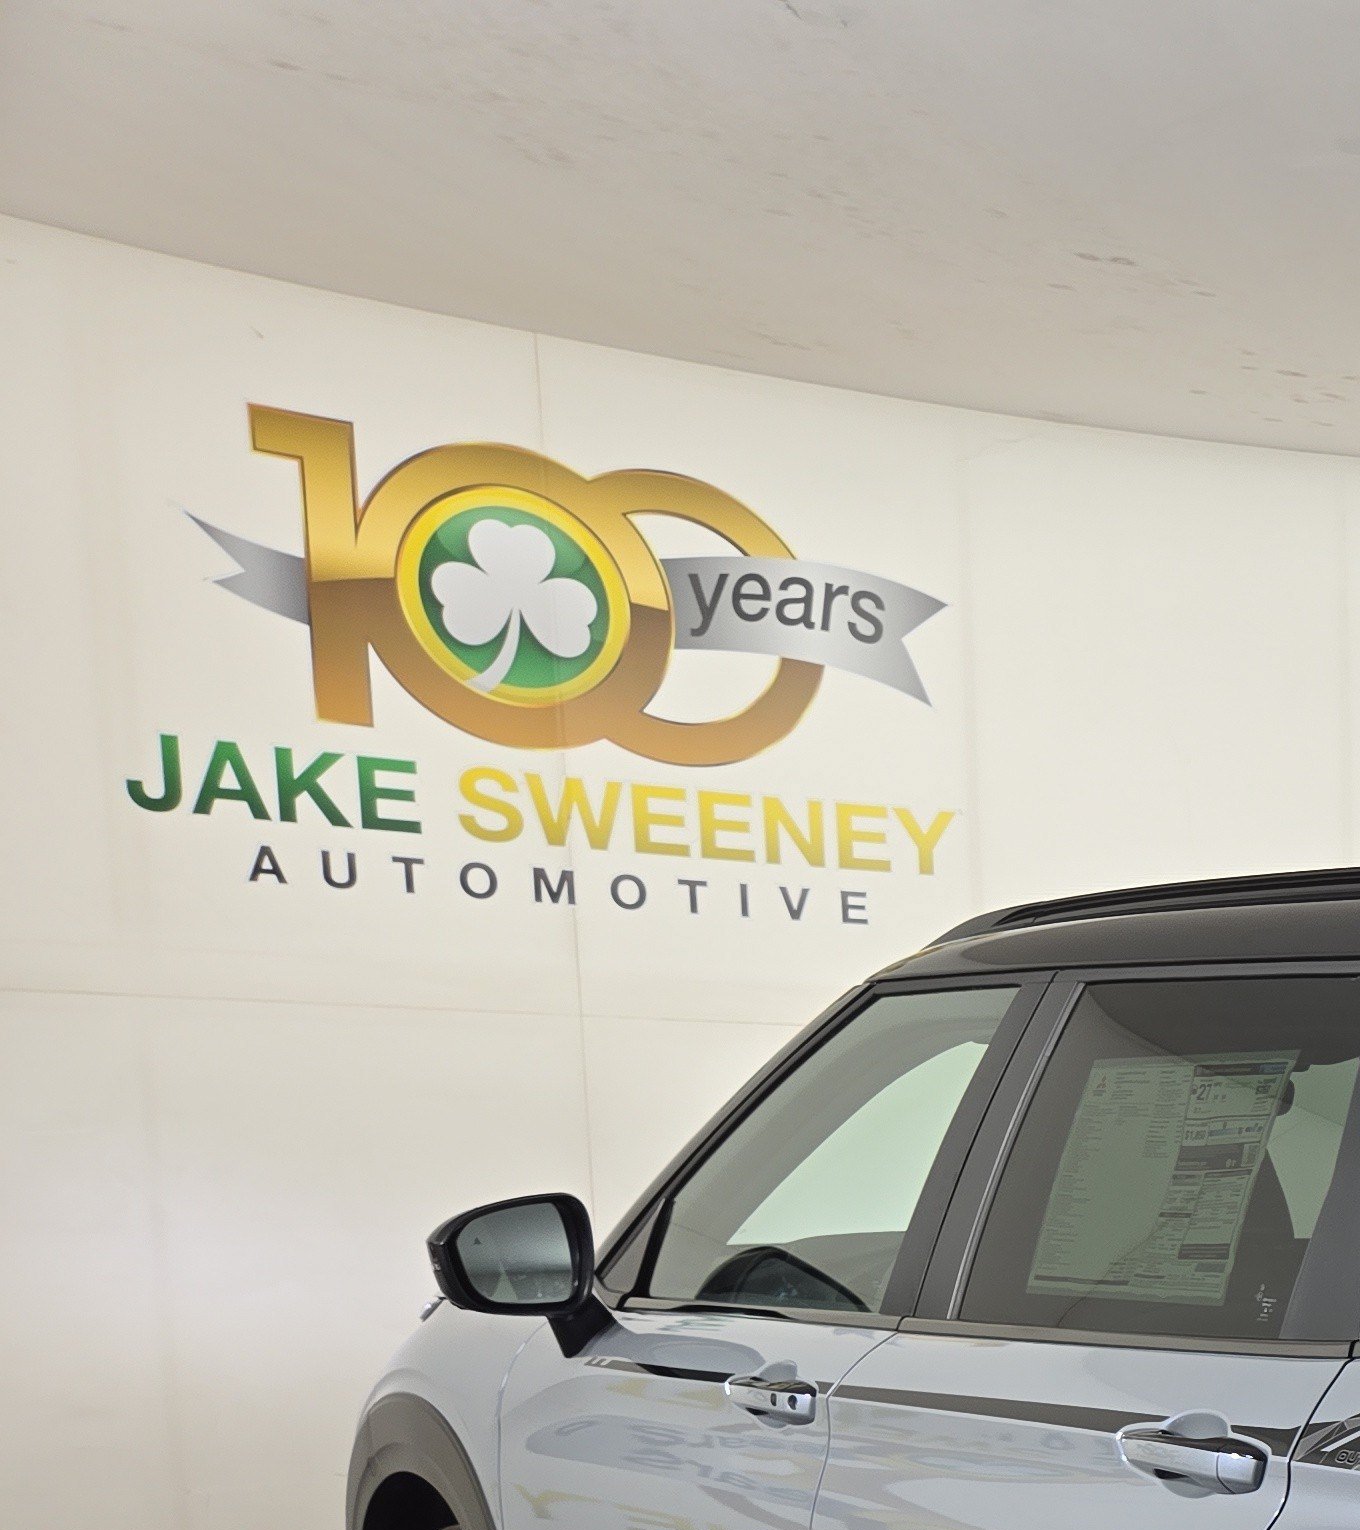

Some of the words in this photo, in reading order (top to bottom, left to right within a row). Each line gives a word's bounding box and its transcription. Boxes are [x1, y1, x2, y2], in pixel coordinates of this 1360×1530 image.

[246, 402, 824, 768] 100
[687, 569, 887, 645] years
[125, 733, 424, 835] JAKE
[457, 765, 956, 877] SWEENEY
[248, 845, 870, 926] AUTOMOTIVE
